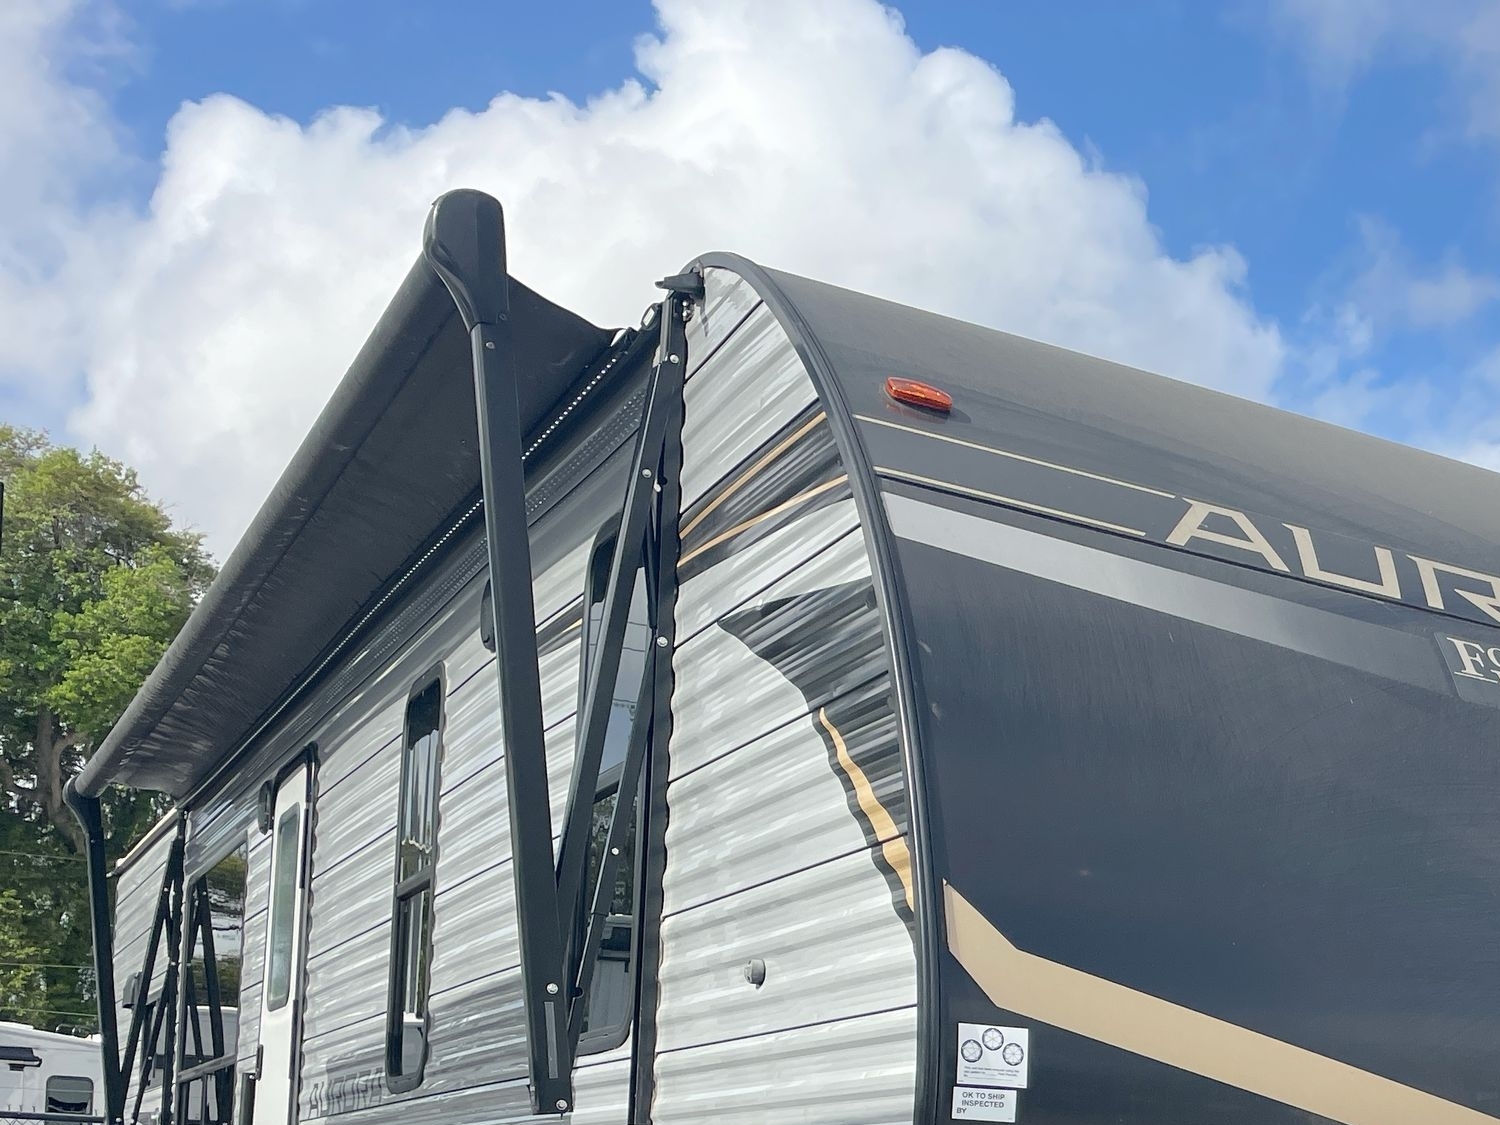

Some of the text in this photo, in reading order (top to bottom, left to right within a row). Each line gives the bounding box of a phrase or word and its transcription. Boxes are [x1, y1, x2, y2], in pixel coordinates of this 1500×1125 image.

[962, 1091, 1006, 1101] OK TO SHIP
[961, 1099, 1005, 1109] INSPECTED
